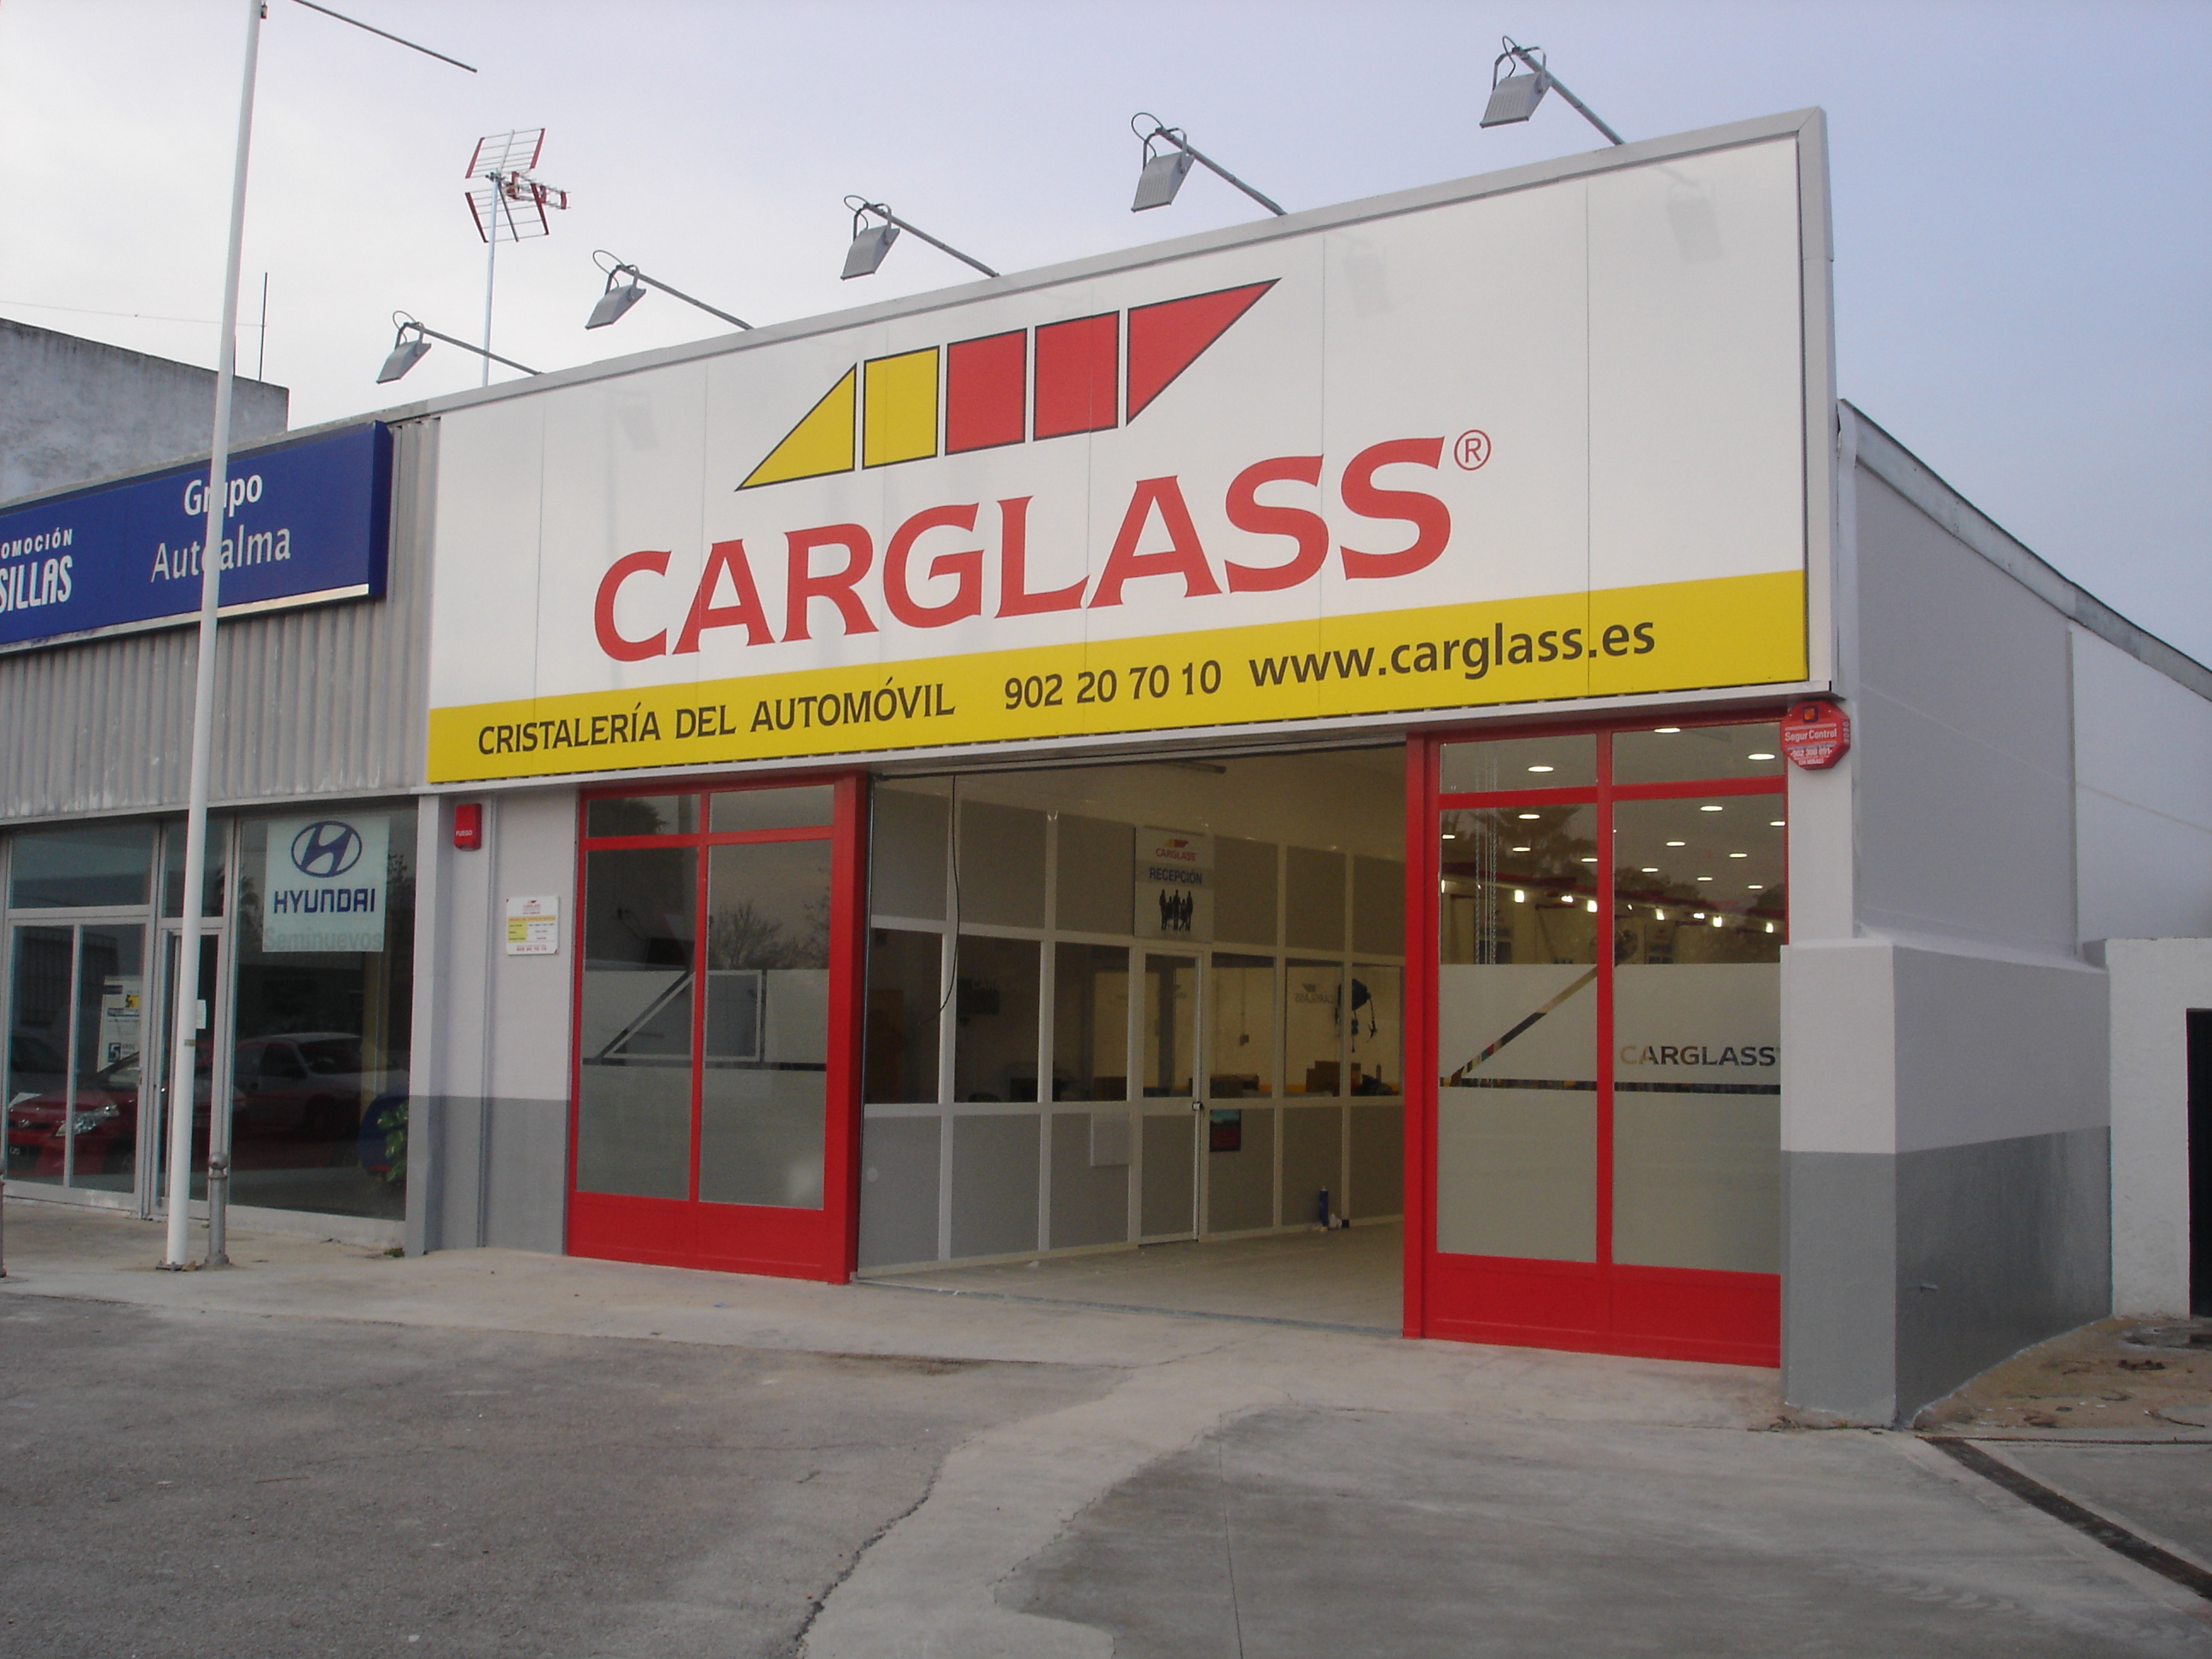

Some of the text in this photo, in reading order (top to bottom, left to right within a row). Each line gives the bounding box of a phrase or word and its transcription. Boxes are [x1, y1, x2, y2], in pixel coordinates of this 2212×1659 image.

[183, 473, 263, 518] Grpo
[150, 523, 292, 584] Autalma
[594, 436, 1452, 662] CARGLASS
[1248, 620, 1656, 688] www.carglass.es
[1004, 660, 1222, 710] 902 20 70 10
[478, 677, 957, 755] CRISTALERÍA DEL AUTOMÓVIL
[1784, 731, 1808, 742] Segur
[1808, 728, 1837, 740] Control
[1155, 847, 1196, 862] CARGLASS
[1149, 867, 1203, 884] RECEPCIÓN
[273, 888, 376, 914] HYUNDAI
[263, 927, 383, 951] Seminuevos
[1620, 1045, 1777, 1067] CARGLASS
